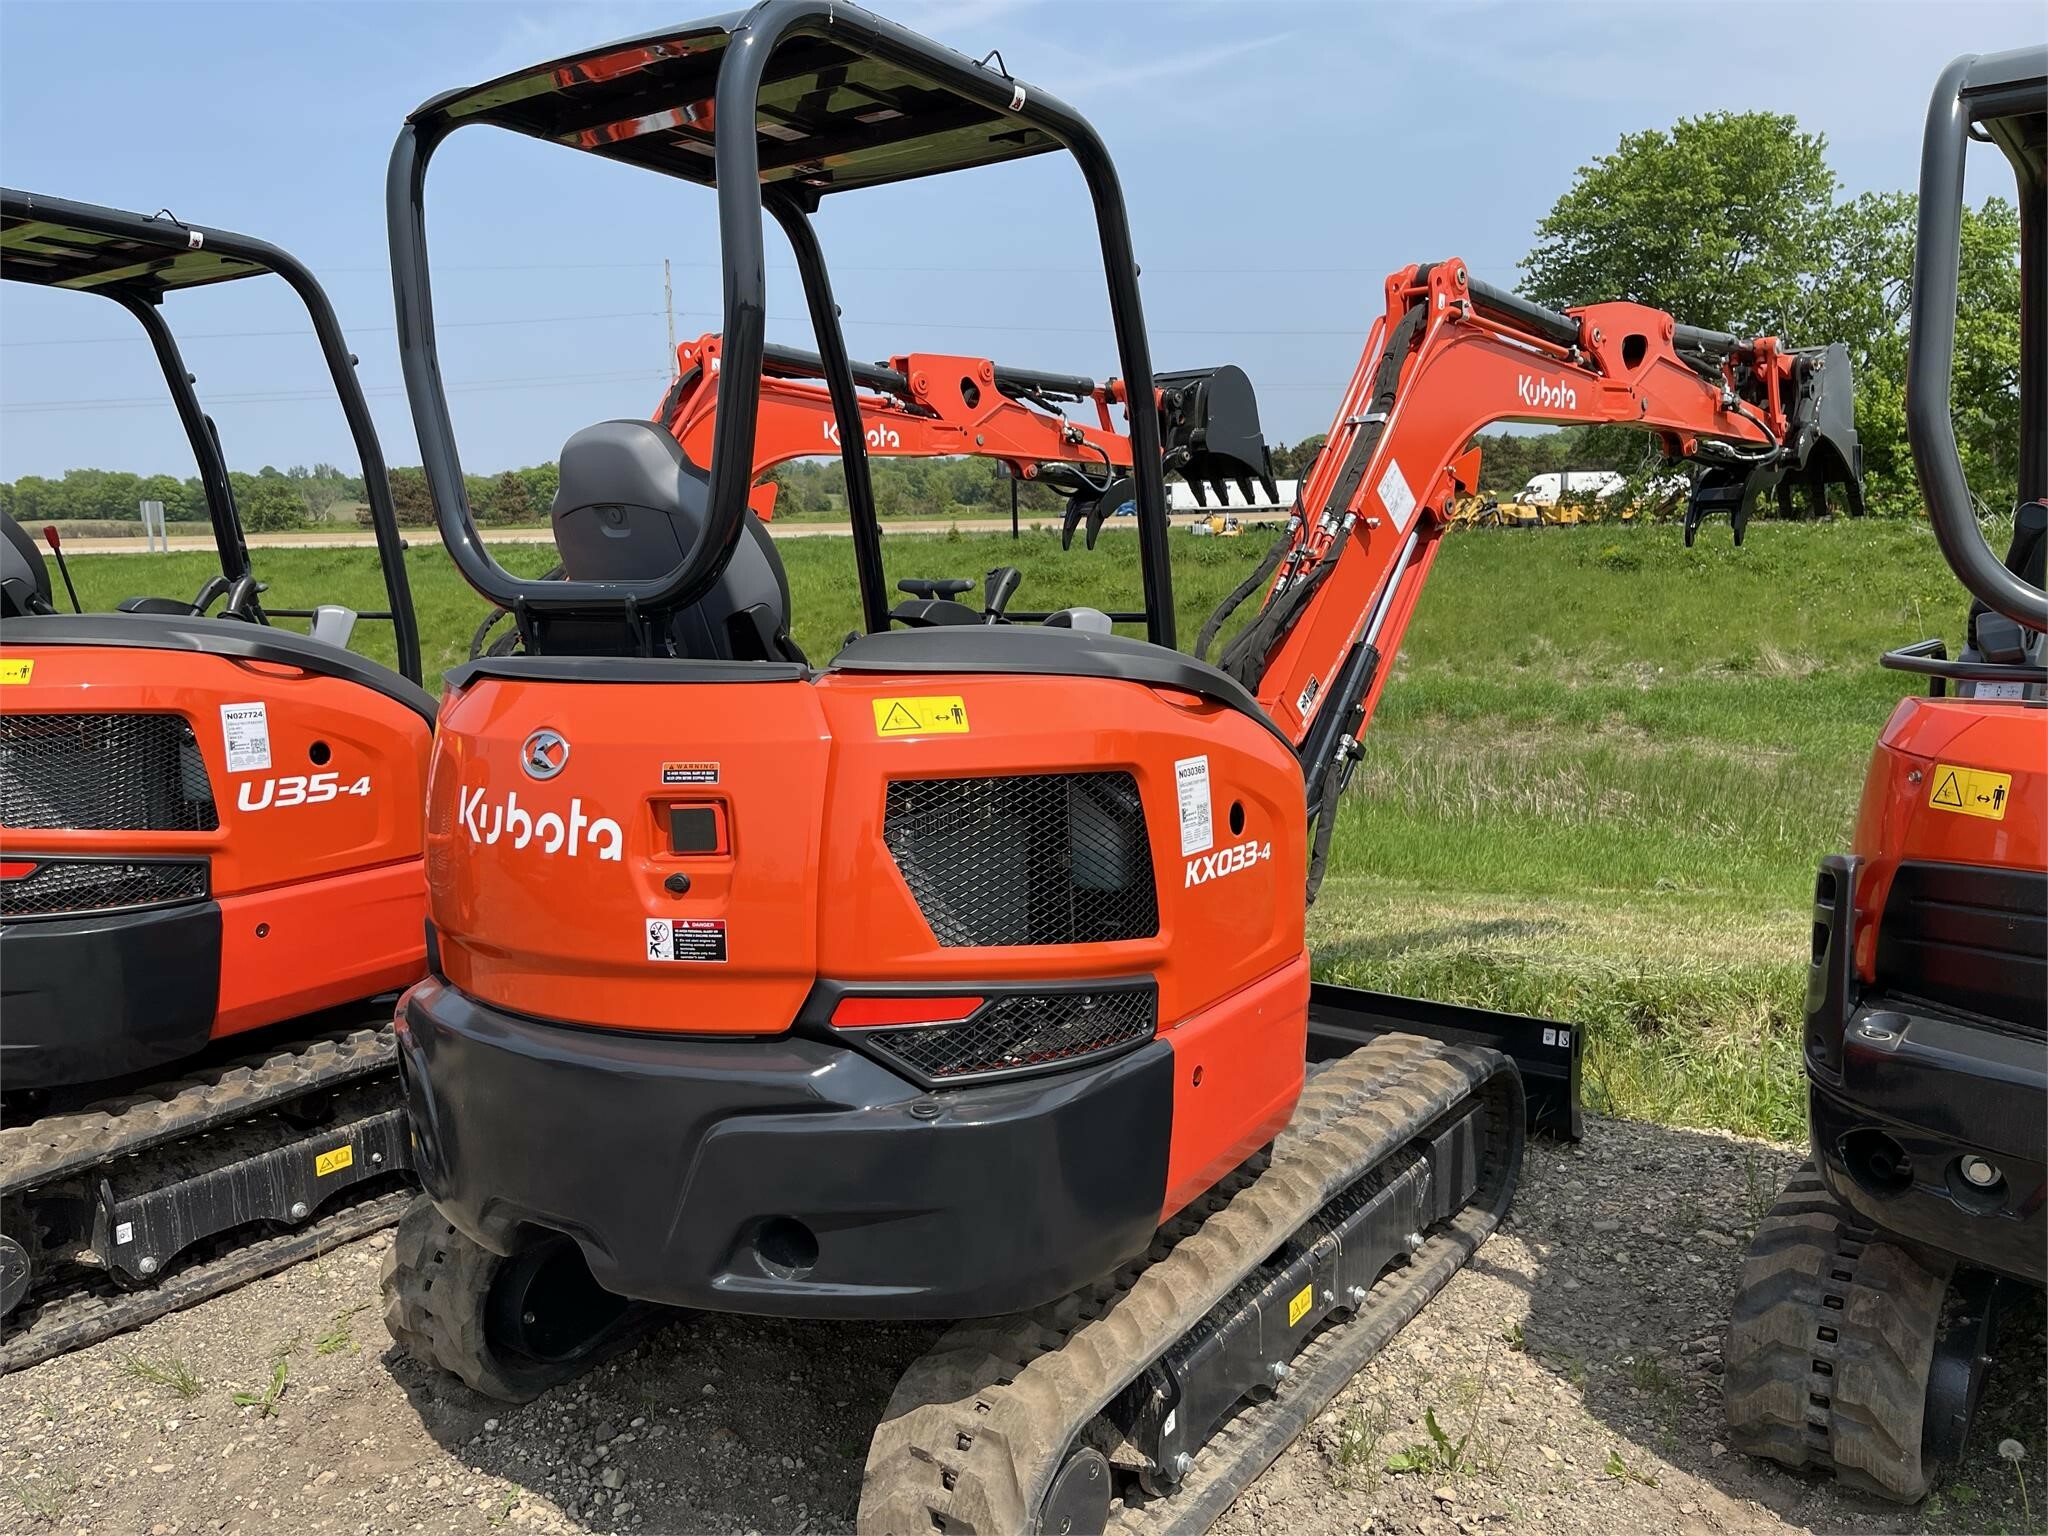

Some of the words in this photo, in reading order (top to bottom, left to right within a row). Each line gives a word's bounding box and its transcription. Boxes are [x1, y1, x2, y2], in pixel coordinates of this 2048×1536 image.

[1518, 374, 1576, 410] Kubota
[823, 420, 900, 448] Kota
[226, 710, 264, 720] N027724
[1178, 765, 1206, 779] N030369
[237, 772, 371, 812] U35-4
[458, 785, 623, 862] Kubota
[1184, 840, 1271, 889] KX033-4
